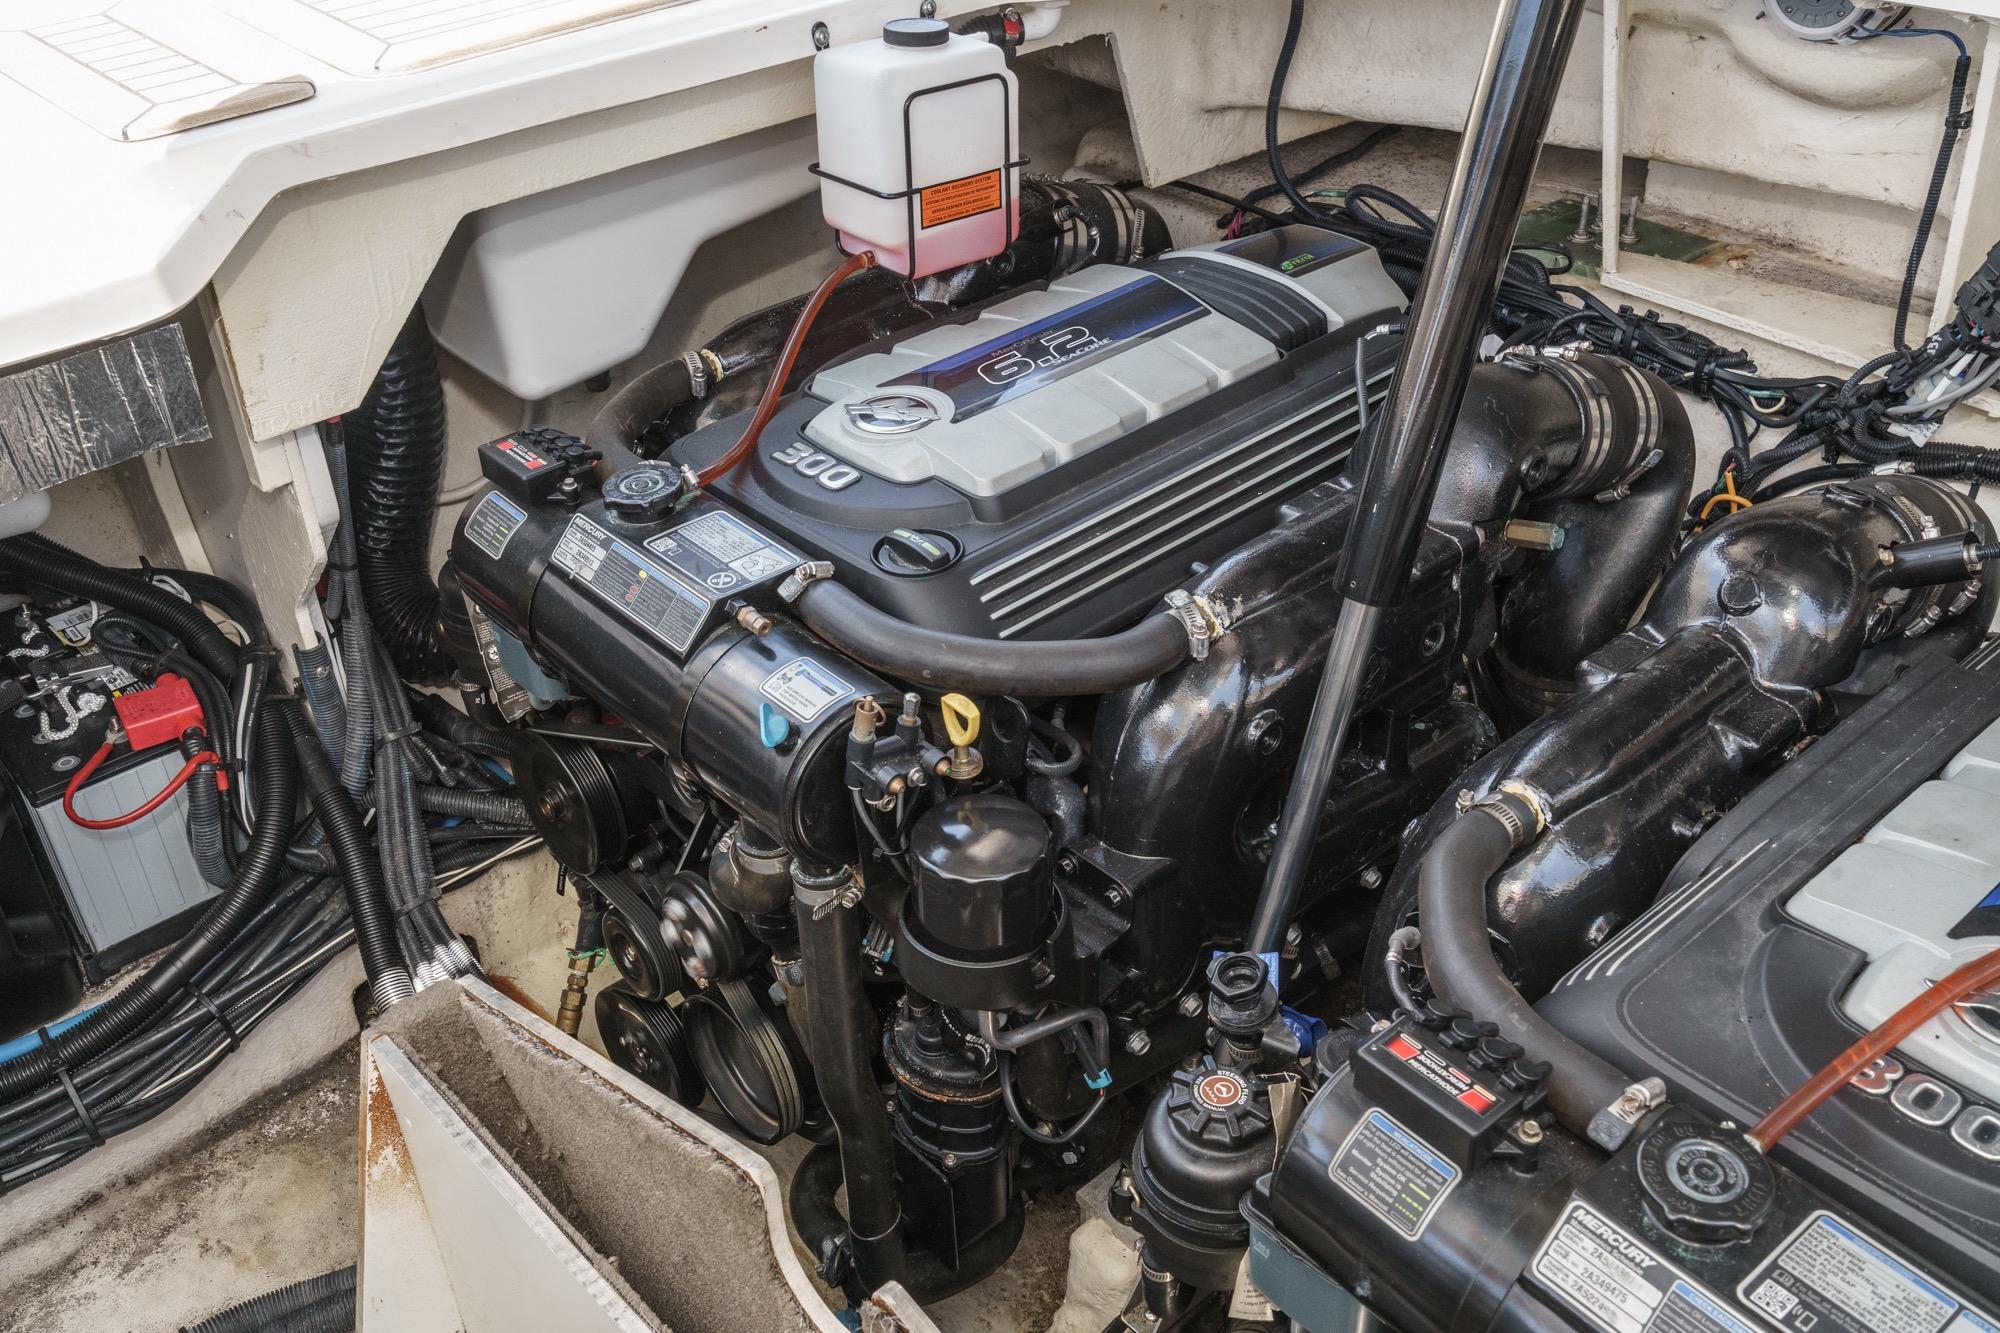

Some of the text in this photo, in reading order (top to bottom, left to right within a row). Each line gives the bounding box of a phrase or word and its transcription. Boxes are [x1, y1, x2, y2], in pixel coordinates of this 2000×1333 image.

[951, 179, 974, 190] RECOVERY
[975, 174, 991, 184] SYSTEM
[977, 326, 1097, 385] 6.2
[771, 440, 862, 491] 300
[574, 516, 606, 542] MERCURY
[1217, 1070, 1249, 1105] STEERING FLUID
[1406, 1058, 1461, 1096] MERCATHODE
[1415, 1053, 1470, 1091] MERCATHODE
[1203, 1102, 1227, 1112] MANUAL
[1351, 1148, 1402, 1190] Monitor System is
[1375, 1157, 1407, 1183] System OK
[1389, 1139, 1400, 1150] LED
[1407, 1153, 1427, 1170] become
[1336, 1167, 1347, 1178] See
[1367, 1193, 1388, 1212] Manual
[1348, 1165, 1393, 1204] Service Required
[1568, 1218, 1613, 1253] Maintenance
[1571, 1206, 1657, 1273] MERCURY
[1810, 1228, 1868, 1266] DISPLACEMENT
[1815, 1223, 1841, 1242] MODEL
[1788, 1249, 1817, 1269] ENGINE
[1816, 1268, 1830, 1278] OIL
[1792, 1245, 1819, 1263] SPARK
[1818, 1261, 1840, 1277] PLUG
[1838, 1275, 1857, 1288] GAP
[1797, 1240, 1823, 1258] SPARK
[1822, 1257, 1849, 1276] PLUGS
[1802, 1236, 1820, 1249] IDLE
[1818, 1247, 1837, 1260] RPM
[1844, 1265, 1880, 1289] NEUTRAL
[1847, 1259, 1865, 1272] RPM
[1579, 1266, 1629, 1303] 2A349475
[1784, 1253, 1817, 1276] MERCURY
[1816, 1274, 1855, 1302] SYNTHETIC
[1852, 1300, 1878, 1318] BLEND
[1797, 1269, 1831, 1294] CATALYST
[1829, 1292, 1873, 1324] COMPATIBLE
